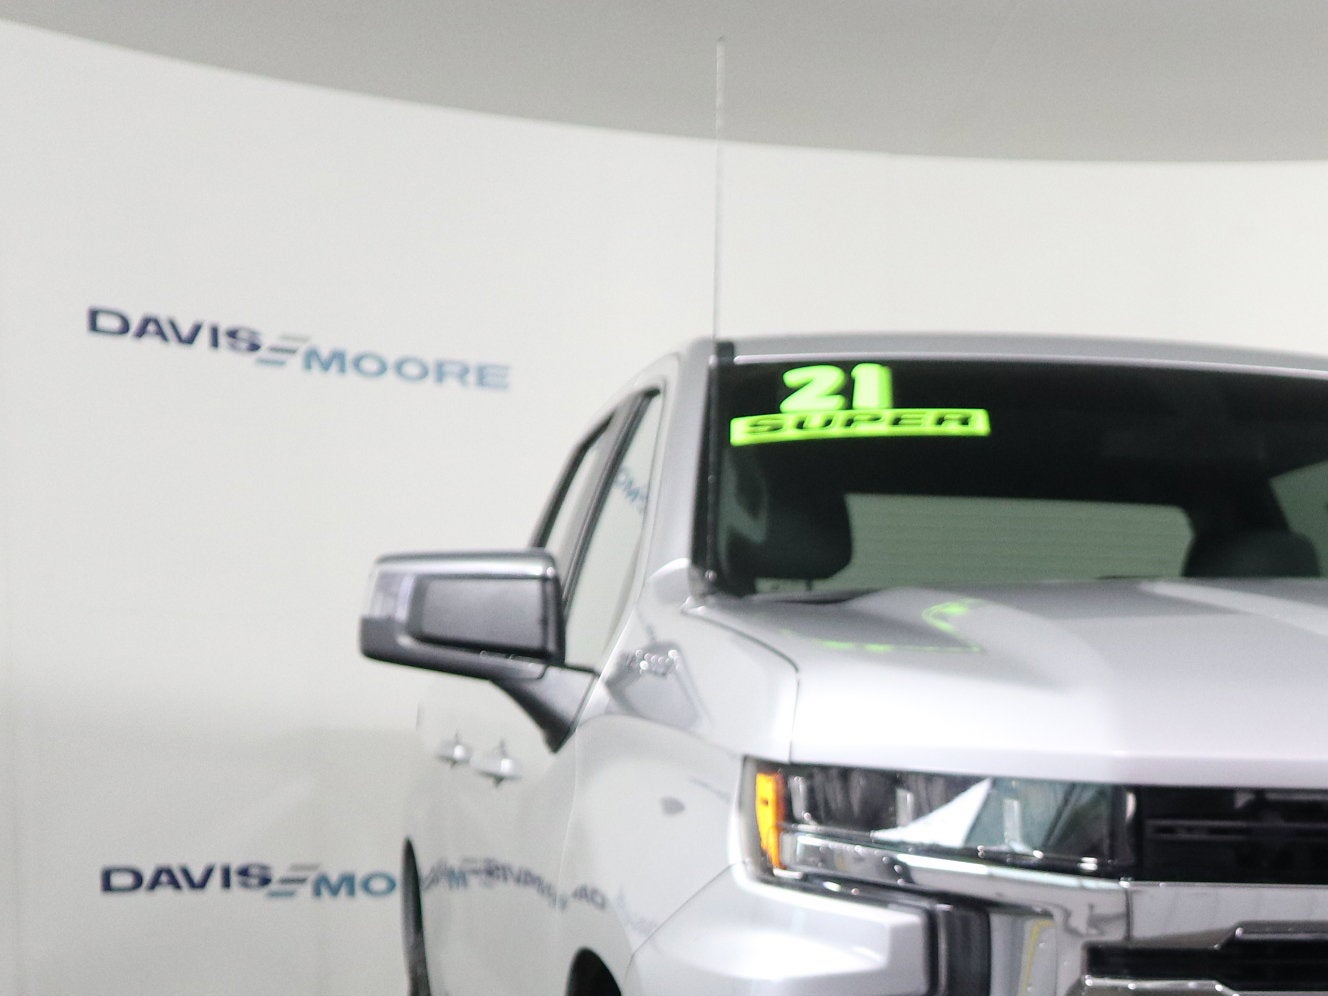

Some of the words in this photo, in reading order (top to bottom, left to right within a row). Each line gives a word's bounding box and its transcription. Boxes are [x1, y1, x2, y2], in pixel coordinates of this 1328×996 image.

[86, 305, 263, 355] DAVIS
[301, 343, 512, 391] MOORE
[779, 362, 893, 411] 21
[745, 409, 973, 436] SUPER
[99, 861, 273, 894] DAVIS
